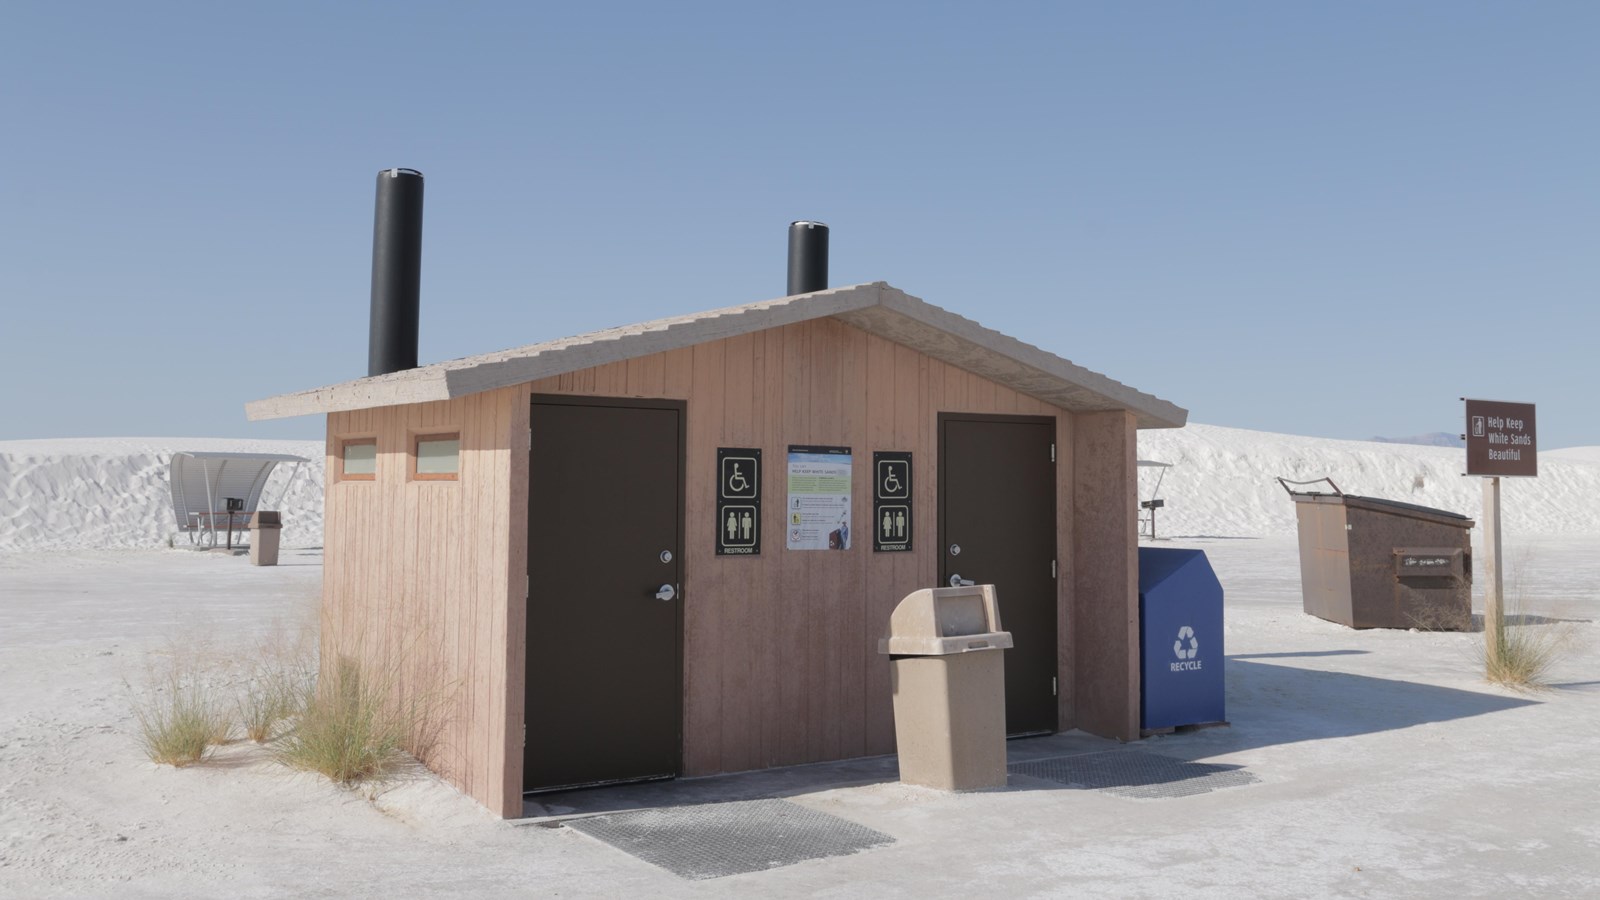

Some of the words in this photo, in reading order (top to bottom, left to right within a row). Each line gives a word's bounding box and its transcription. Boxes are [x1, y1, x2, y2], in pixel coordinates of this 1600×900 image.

[1487, 416, 1504, 431] Help
[1506, 417, 1524, 432] Keep
[1488, 432, 1509, 444] White
[1510, 433, 1532, 446] Sands
[1488, 448, 1521, 461] Beautiful
[1170, 660, 1202, 672] RECYCLE
